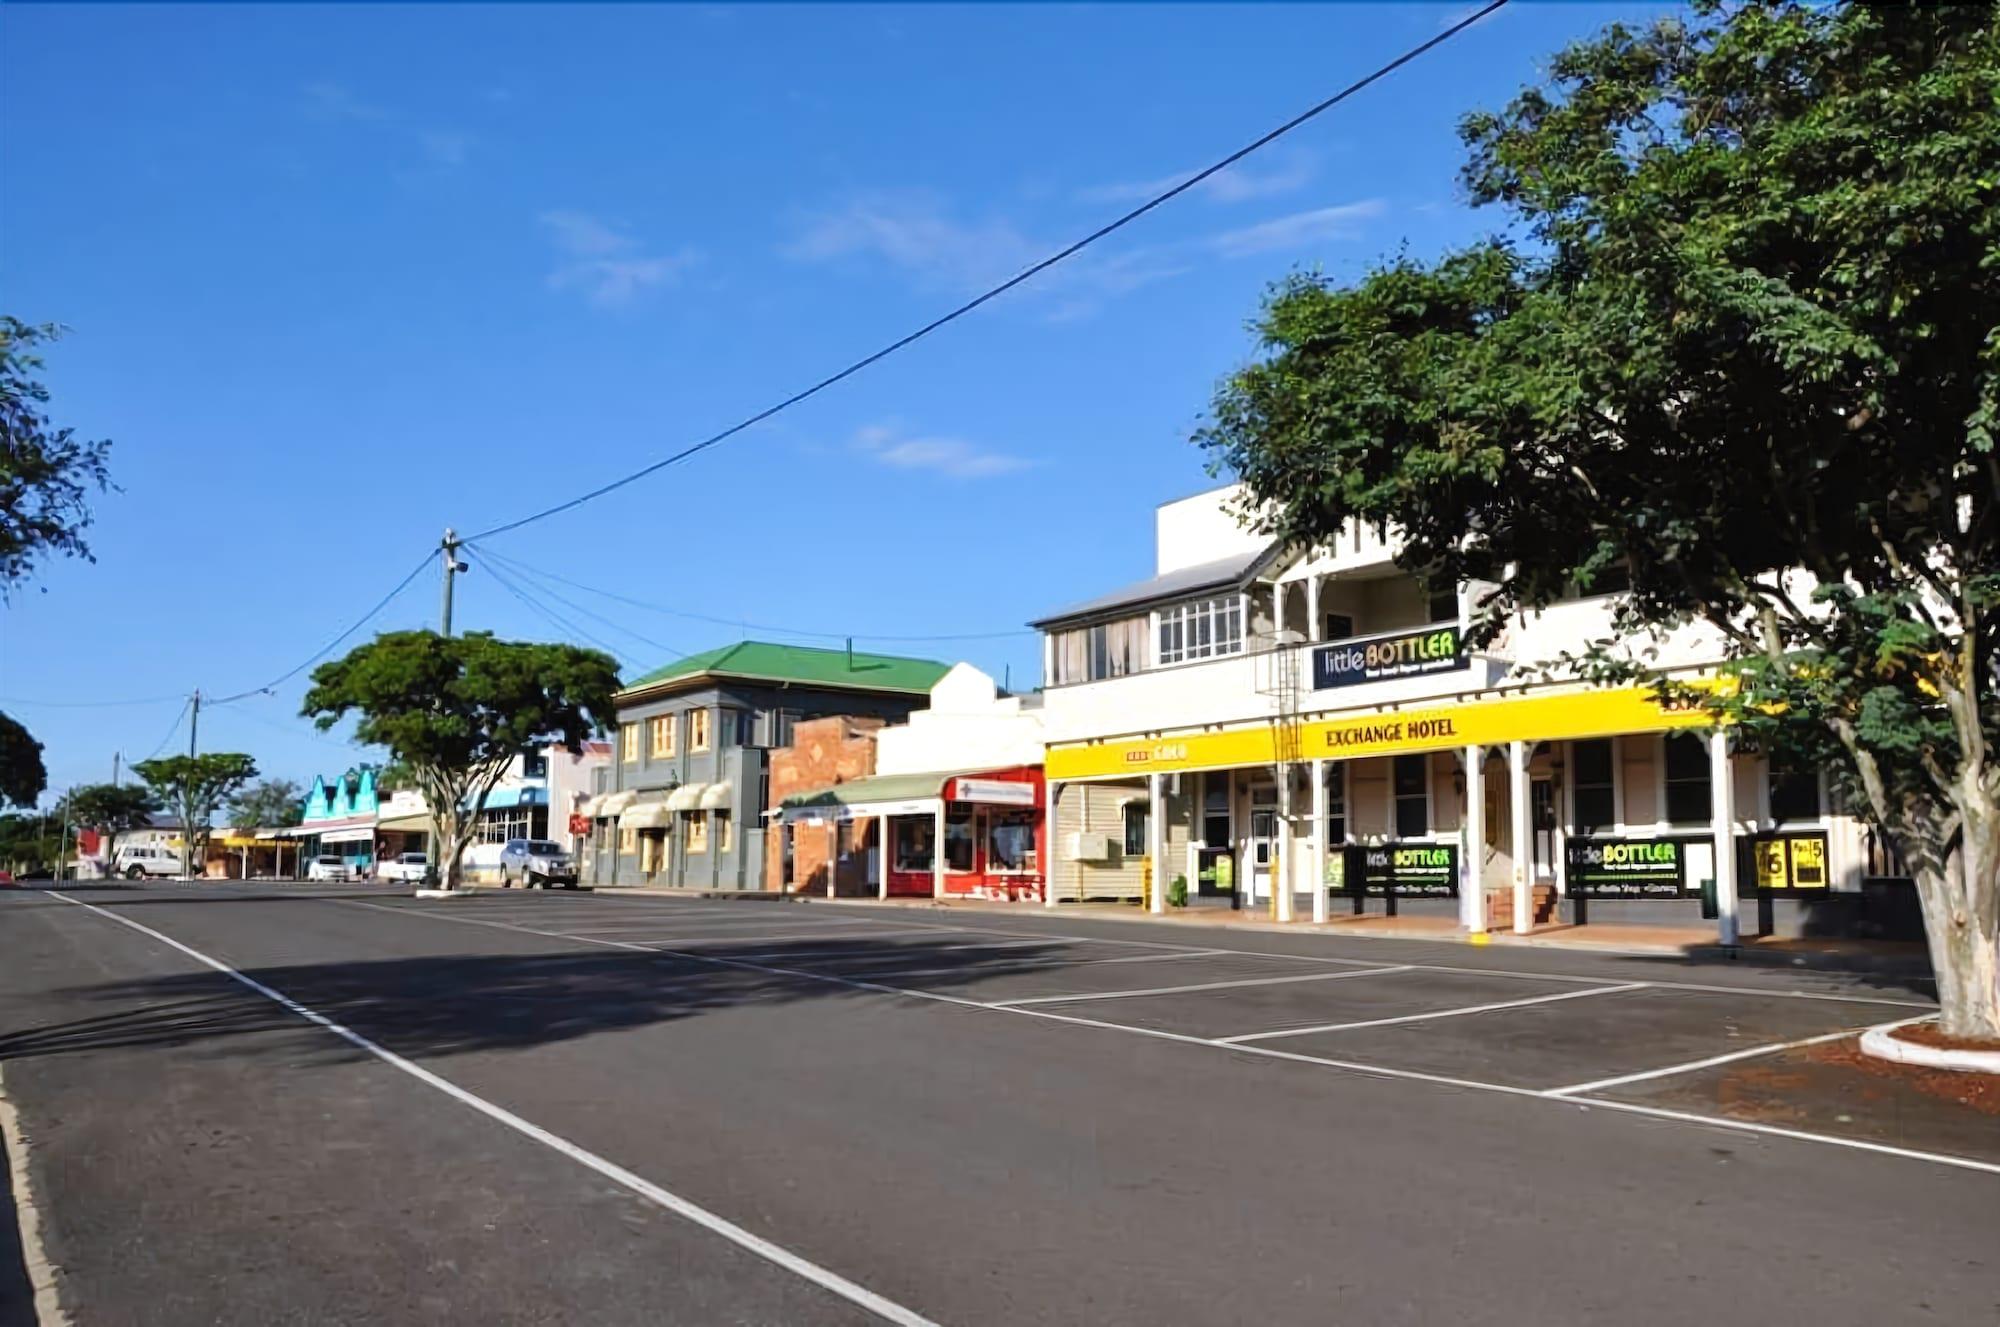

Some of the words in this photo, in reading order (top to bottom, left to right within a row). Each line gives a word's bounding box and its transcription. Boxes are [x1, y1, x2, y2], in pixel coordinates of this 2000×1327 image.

[1325, 648, 1365, 676] little
[1366, 631, 1454, 667] BOTTLER
[1326, 723, 1403, 747] EXCHANGE
[1407, 718, 1457, 739] HOTEL
[1602, 843, 1676, 864] BOTTLER
